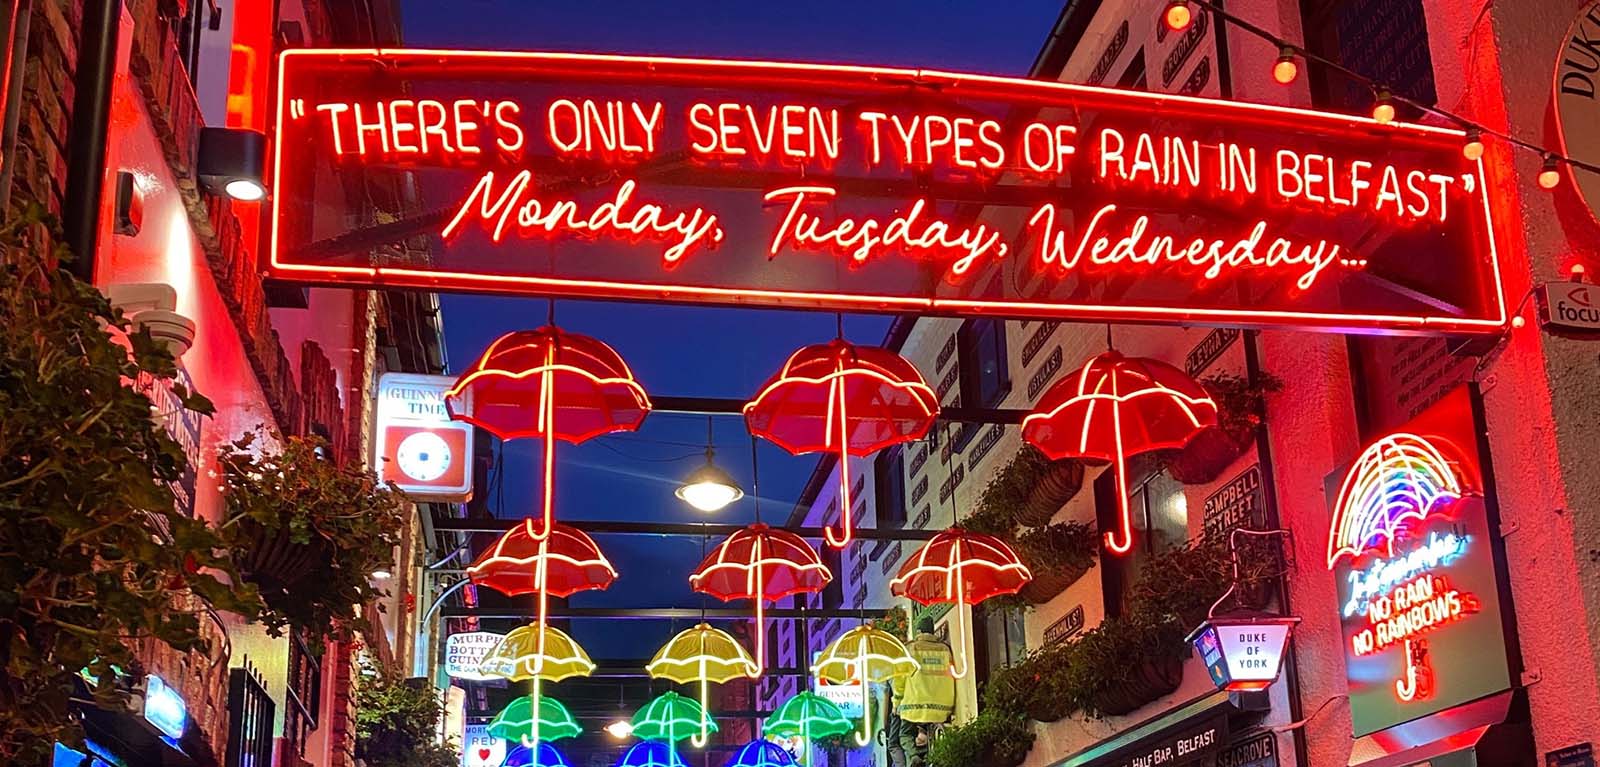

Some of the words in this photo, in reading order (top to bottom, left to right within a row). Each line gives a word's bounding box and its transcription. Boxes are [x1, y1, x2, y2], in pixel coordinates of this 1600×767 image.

[547, 98, 664, 153] ONLY
[690, 103, 840, 159] SEVEN
[859, 110, 1006, 169] TYPES
[1023, 121, 1078, 174] OF
[1099, 128, 1200, 188] RAIN
[1219, 142, 1257, 194] IN
[442, 168, 725, 263] Monday,
[762, 185, 1009, 276] Tuesday,
[1558, 301, 1600, 322] focu
[1186, 331, 1222, 376] PLEVNA
[408, 402, 446, 415] TIME
[1204, 473, 1258, 519] CAMPBELL
[1370, 597, 1391, 624] NO
[1395, 574, 1433, 610] RAIN
[1240, 633, 1267, 642] DUKE
[1352, 629, 1374, 656] NO
[1376, 591, 1461, 646] RAINBOWS
[1240, 659, 1267, 668] YORK
[1247, 647, 1260, 655] OF
[472, 737, 497, 746] RED
[1132, 754, 1153, 767] HALF
[1153, 746, 1174, 764] BAP,
[1177, 729, 1216, 756] BELFAST
